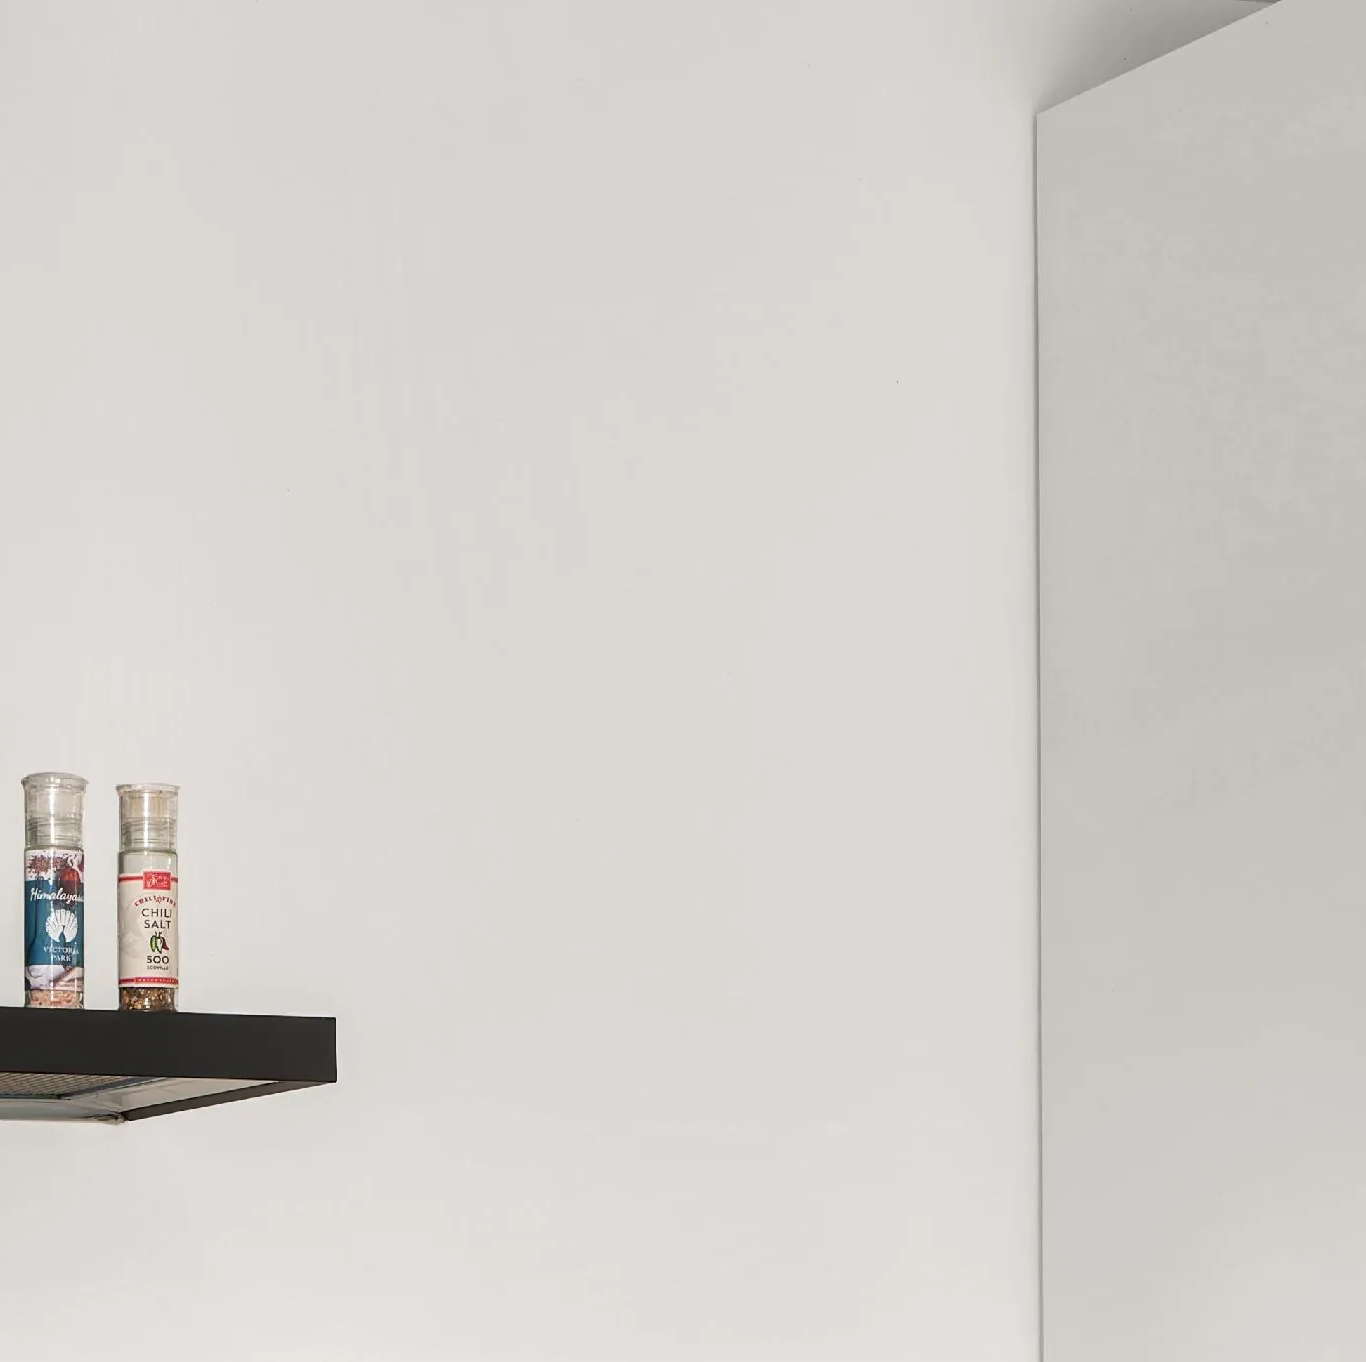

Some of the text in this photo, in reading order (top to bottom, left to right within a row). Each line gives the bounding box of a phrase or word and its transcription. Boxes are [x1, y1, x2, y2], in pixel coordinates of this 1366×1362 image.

[141, 908, 172, 918] CHILI
[144, 920, 172, 929] SALT
[146, 955, 170, 964] 500
